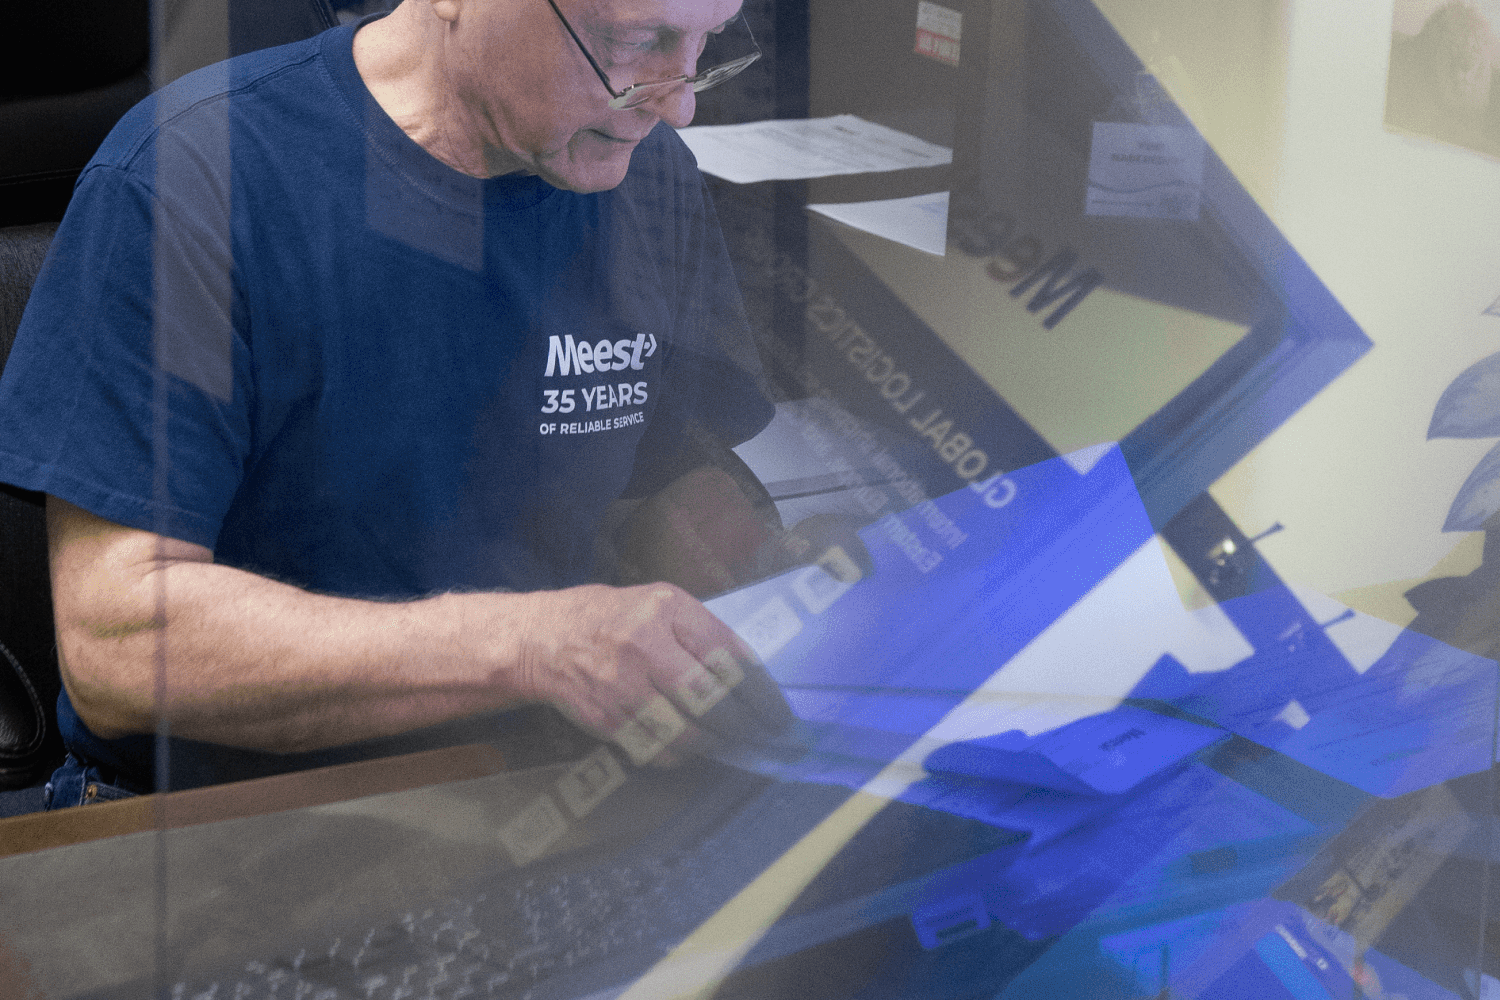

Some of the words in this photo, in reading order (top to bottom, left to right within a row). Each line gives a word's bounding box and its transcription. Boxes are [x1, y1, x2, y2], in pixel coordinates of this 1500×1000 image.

[544, 334, 645, 377] Meest
[541, 390, 575, 413] 35
[581, 382, 648, 411] YEARS
[539, 423, 556, 434] OF
[560, 419, 611, 434] RELIABLE
[613, 412, 645, 429] SERVICE
